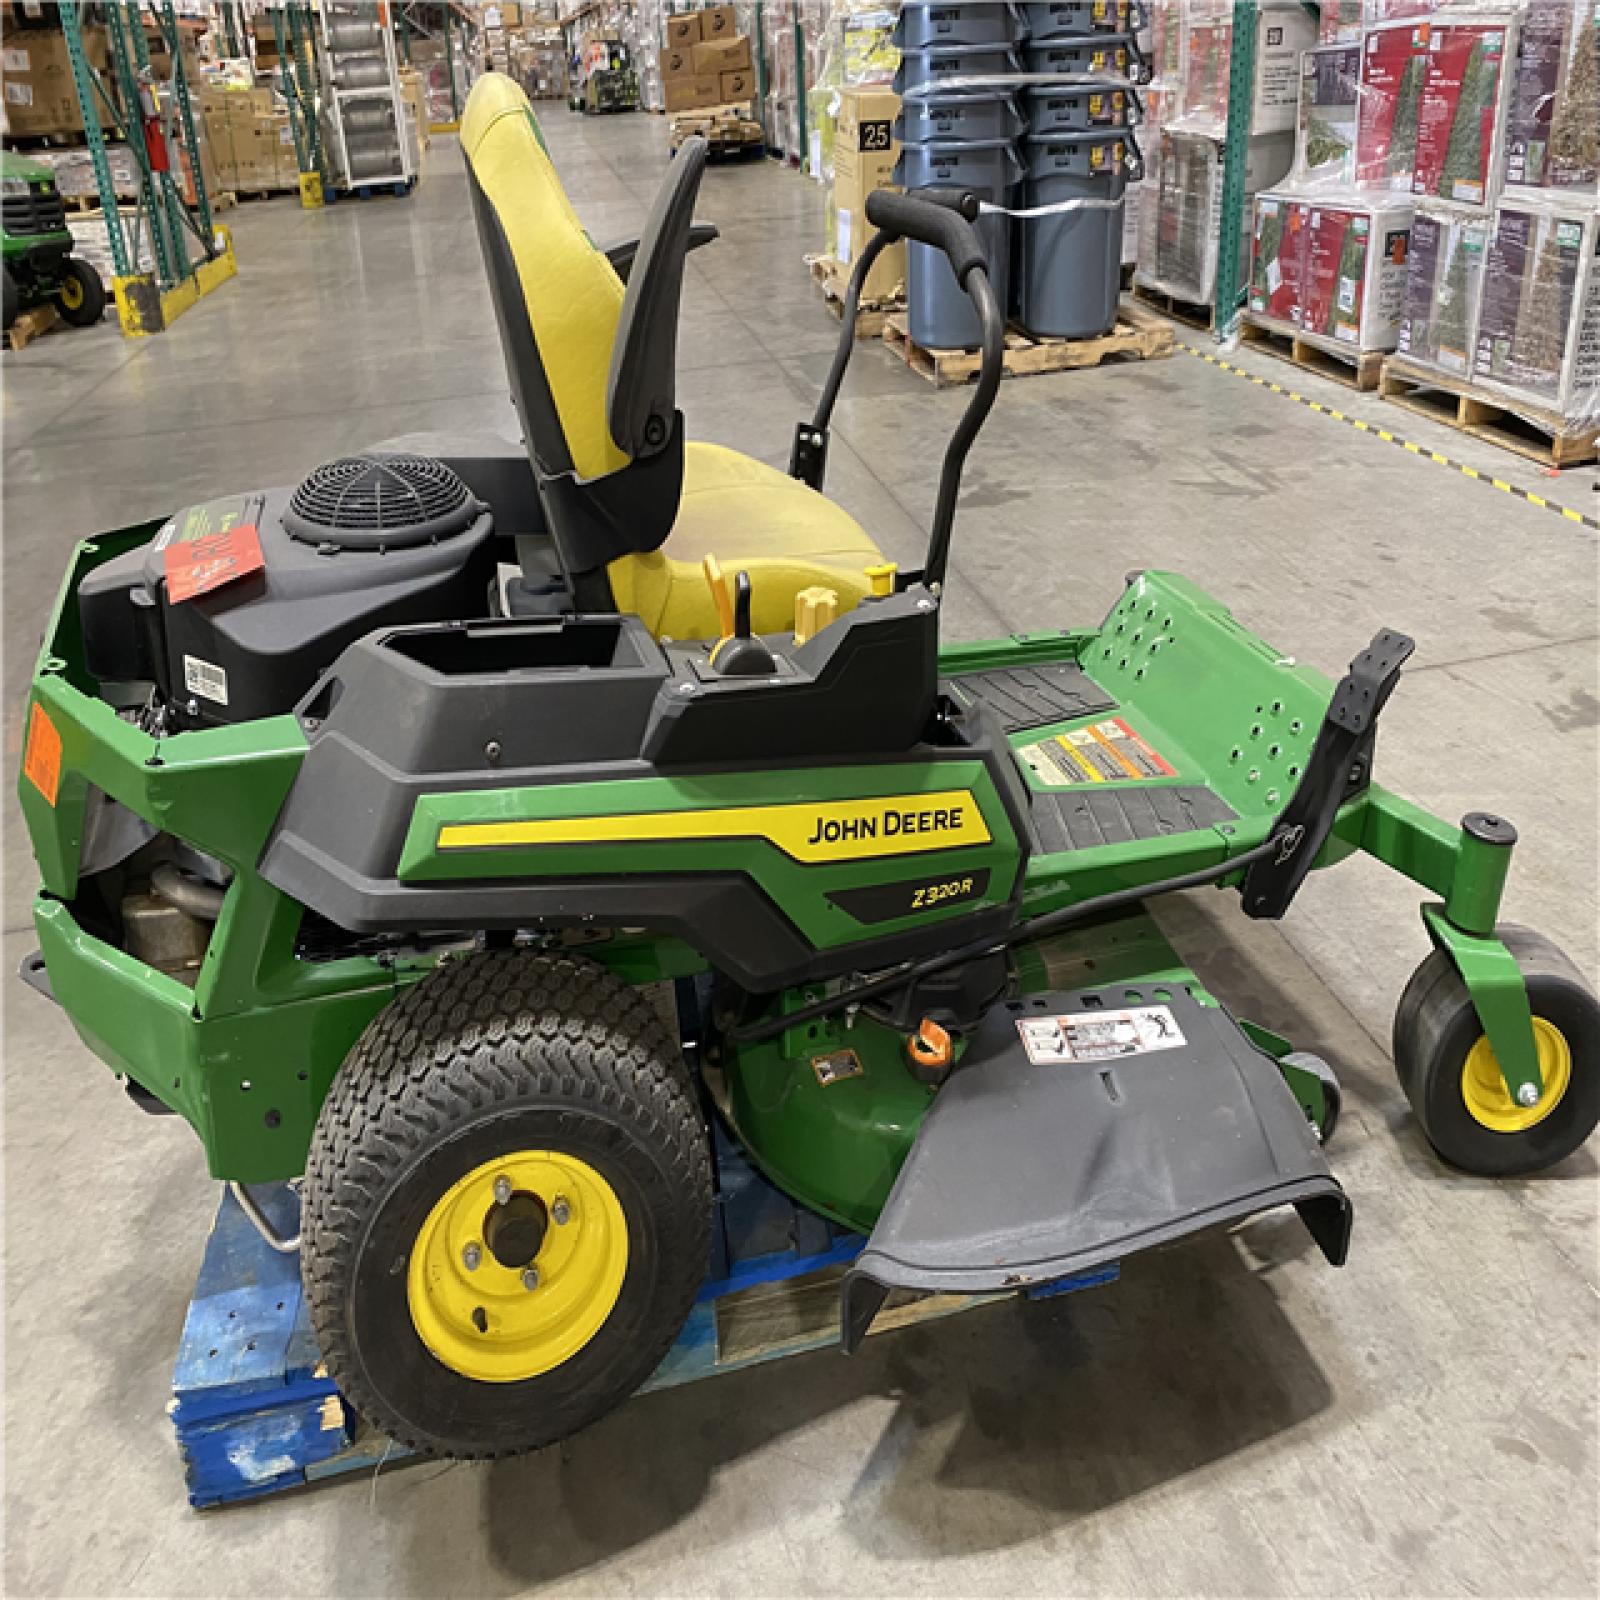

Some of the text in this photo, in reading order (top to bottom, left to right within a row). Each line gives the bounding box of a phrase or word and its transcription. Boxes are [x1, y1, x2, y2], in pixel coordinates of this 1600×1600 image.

[864, 124, 888, 148] 25
[808, 807, 963, 845] JOHN DEERE
